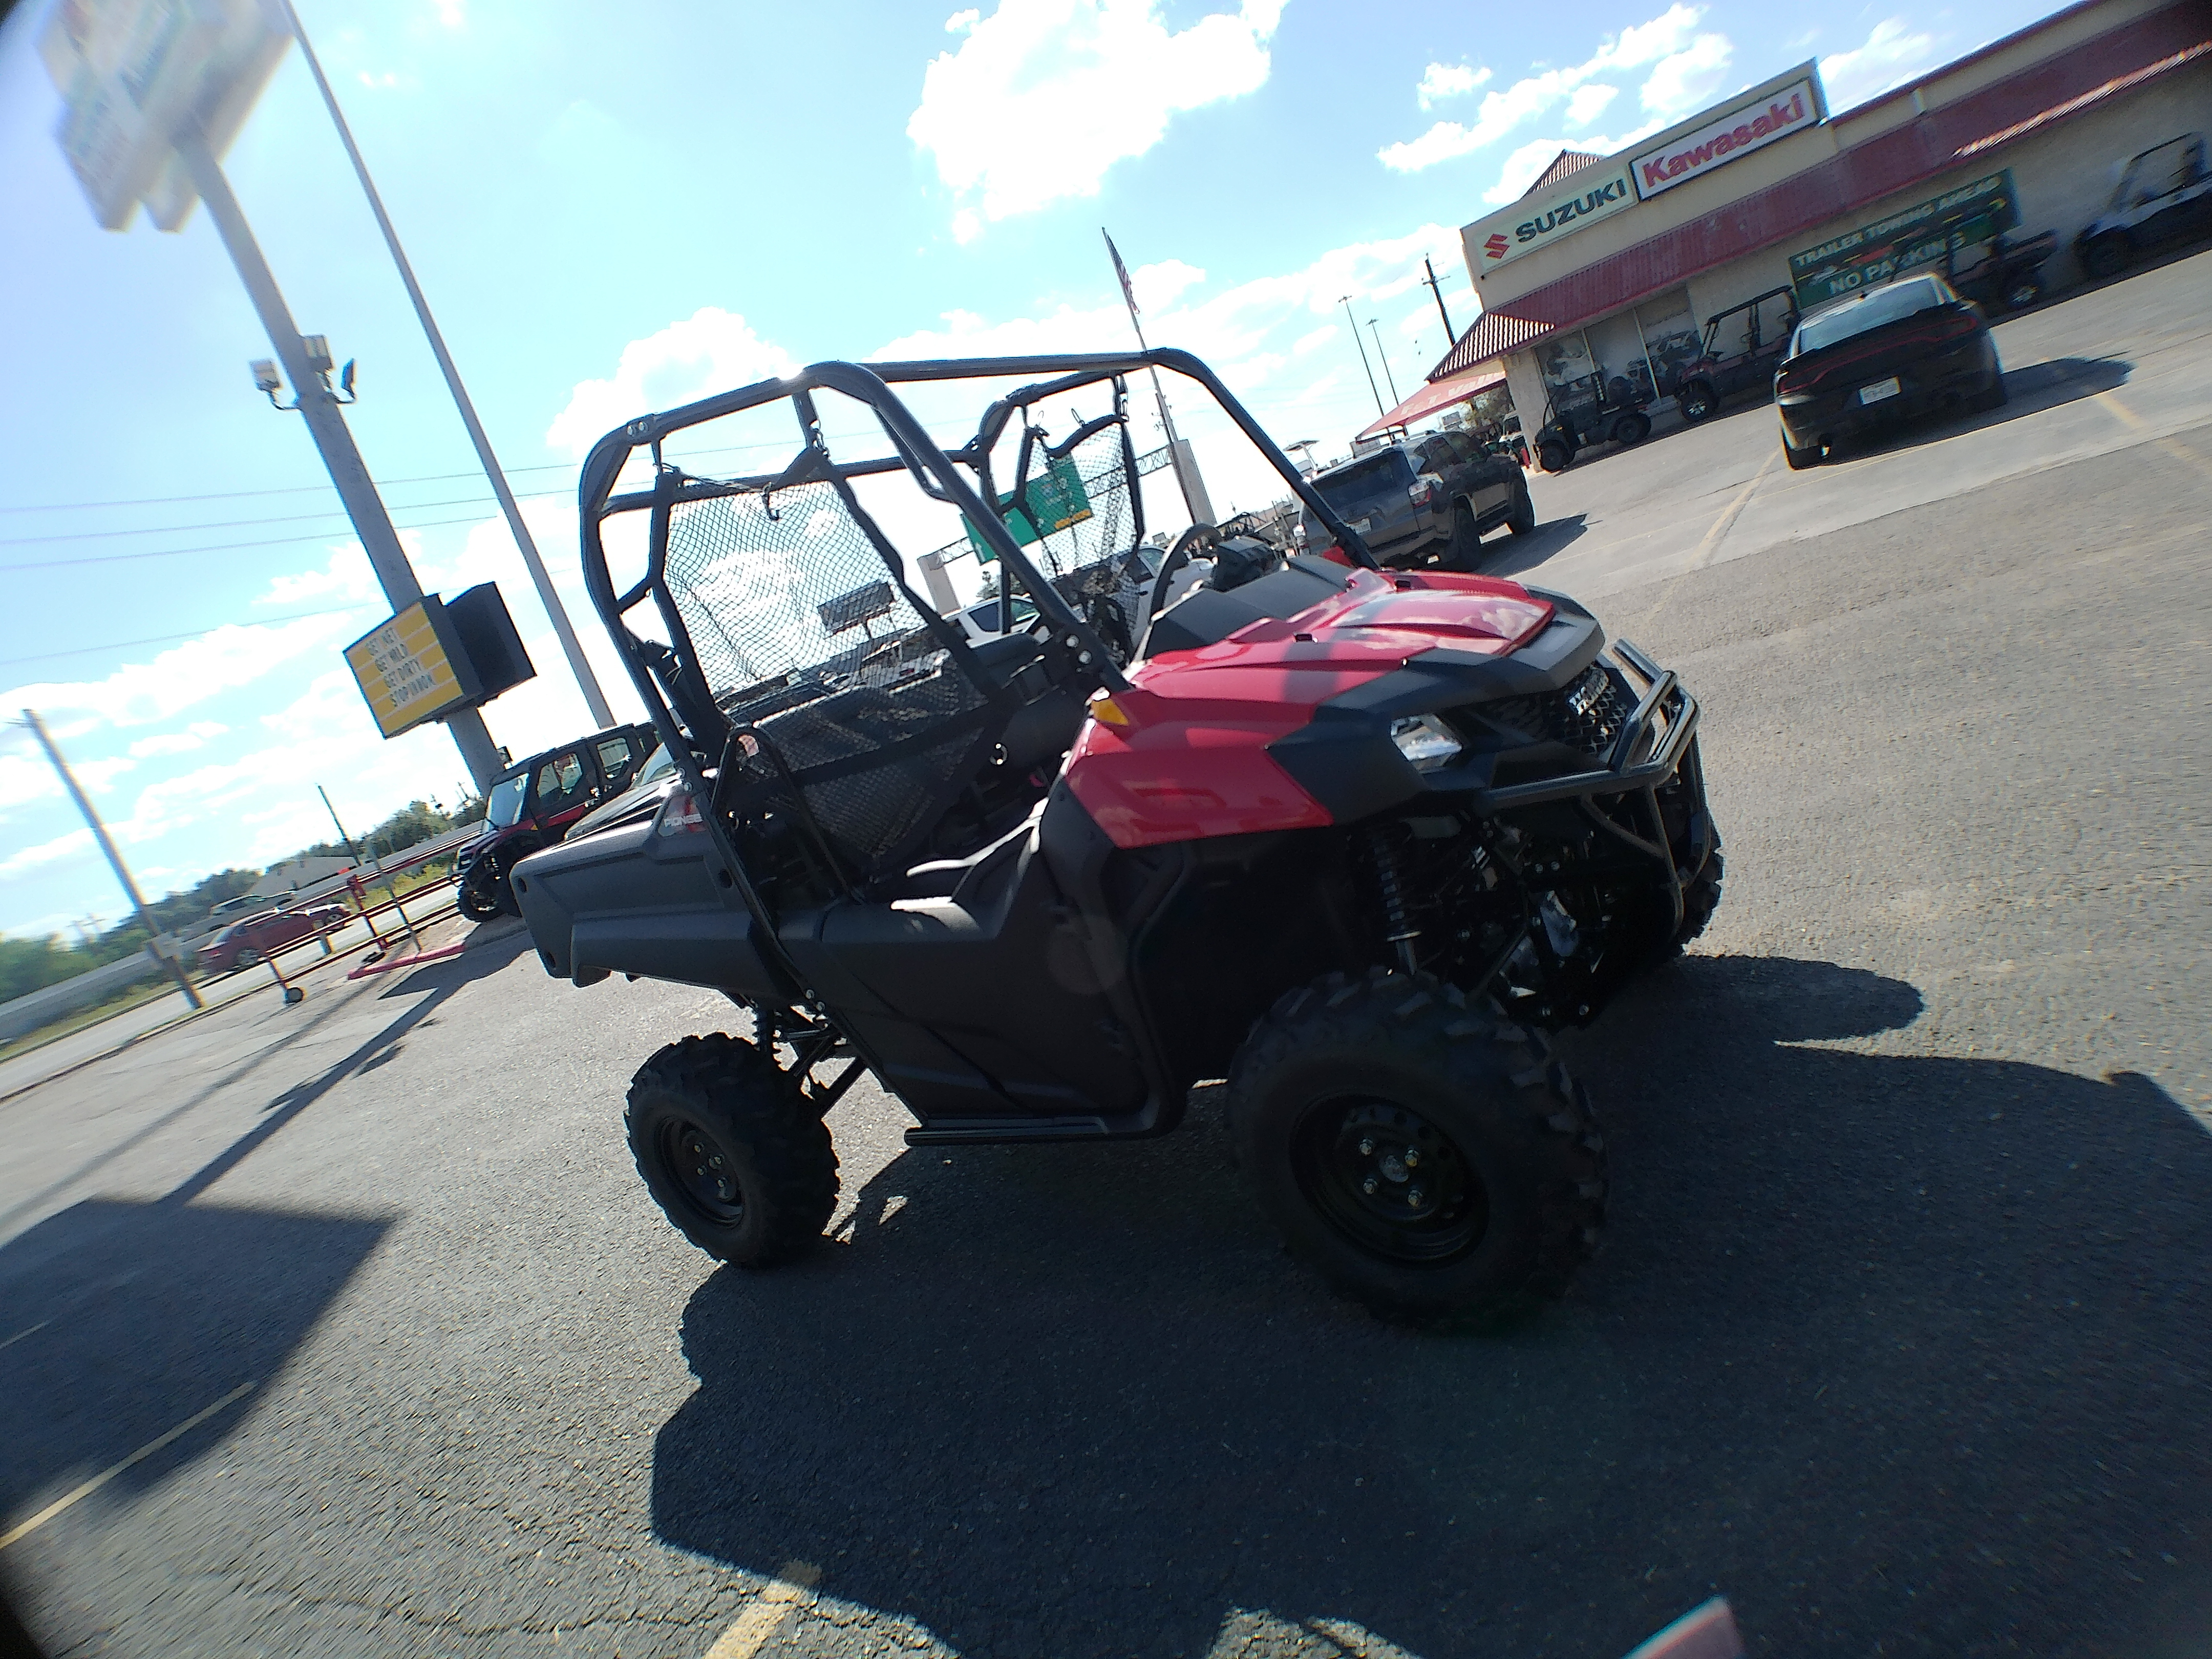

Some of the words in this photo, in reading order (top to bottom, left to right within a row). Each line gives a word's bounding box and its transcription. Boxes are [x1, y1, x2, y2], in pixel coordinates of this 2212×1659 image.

[1642, 93, 1805, 189] Kawasaki
[1516, 178, 1627, 243] SUZUKI
[1795, 231, 1864, 268] TRAILER
[1828, 273, 1862, 295] NO
[664, 813, 703, 827] PIONEE
